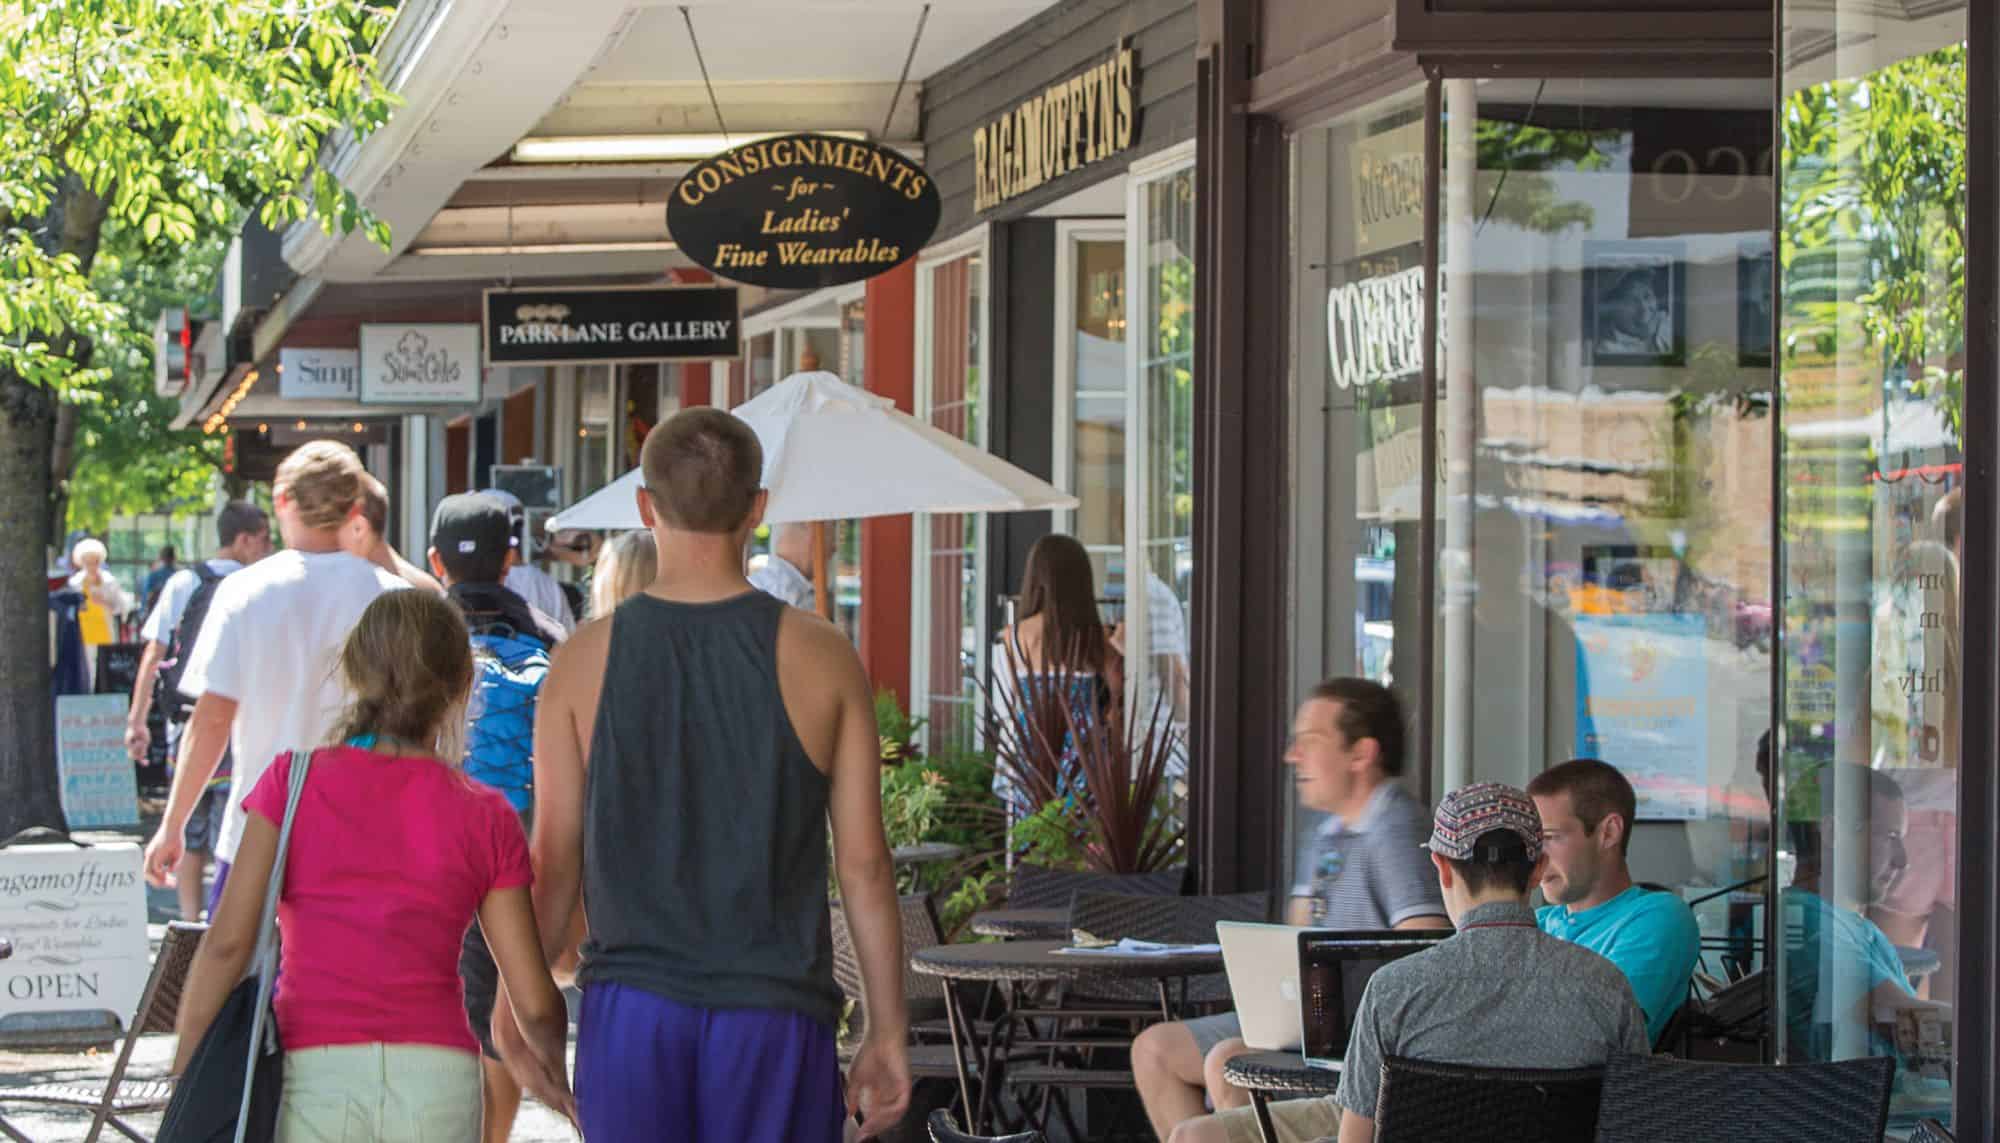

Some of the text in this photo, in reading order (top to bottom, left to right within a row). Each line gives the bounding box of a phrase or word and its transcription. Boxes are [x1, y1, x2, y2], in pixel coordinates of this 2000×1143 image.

[679, 139, 927, 205] CONSIGNMENTS
[786, 176, 818, 201] for
[761, 207, 849, 234] Ladies'
[714, 239, 899, 268] Fine Wearables
[628, 320, 731, 342] GALLERY
[8, 972, 99, 1000] OPEN
